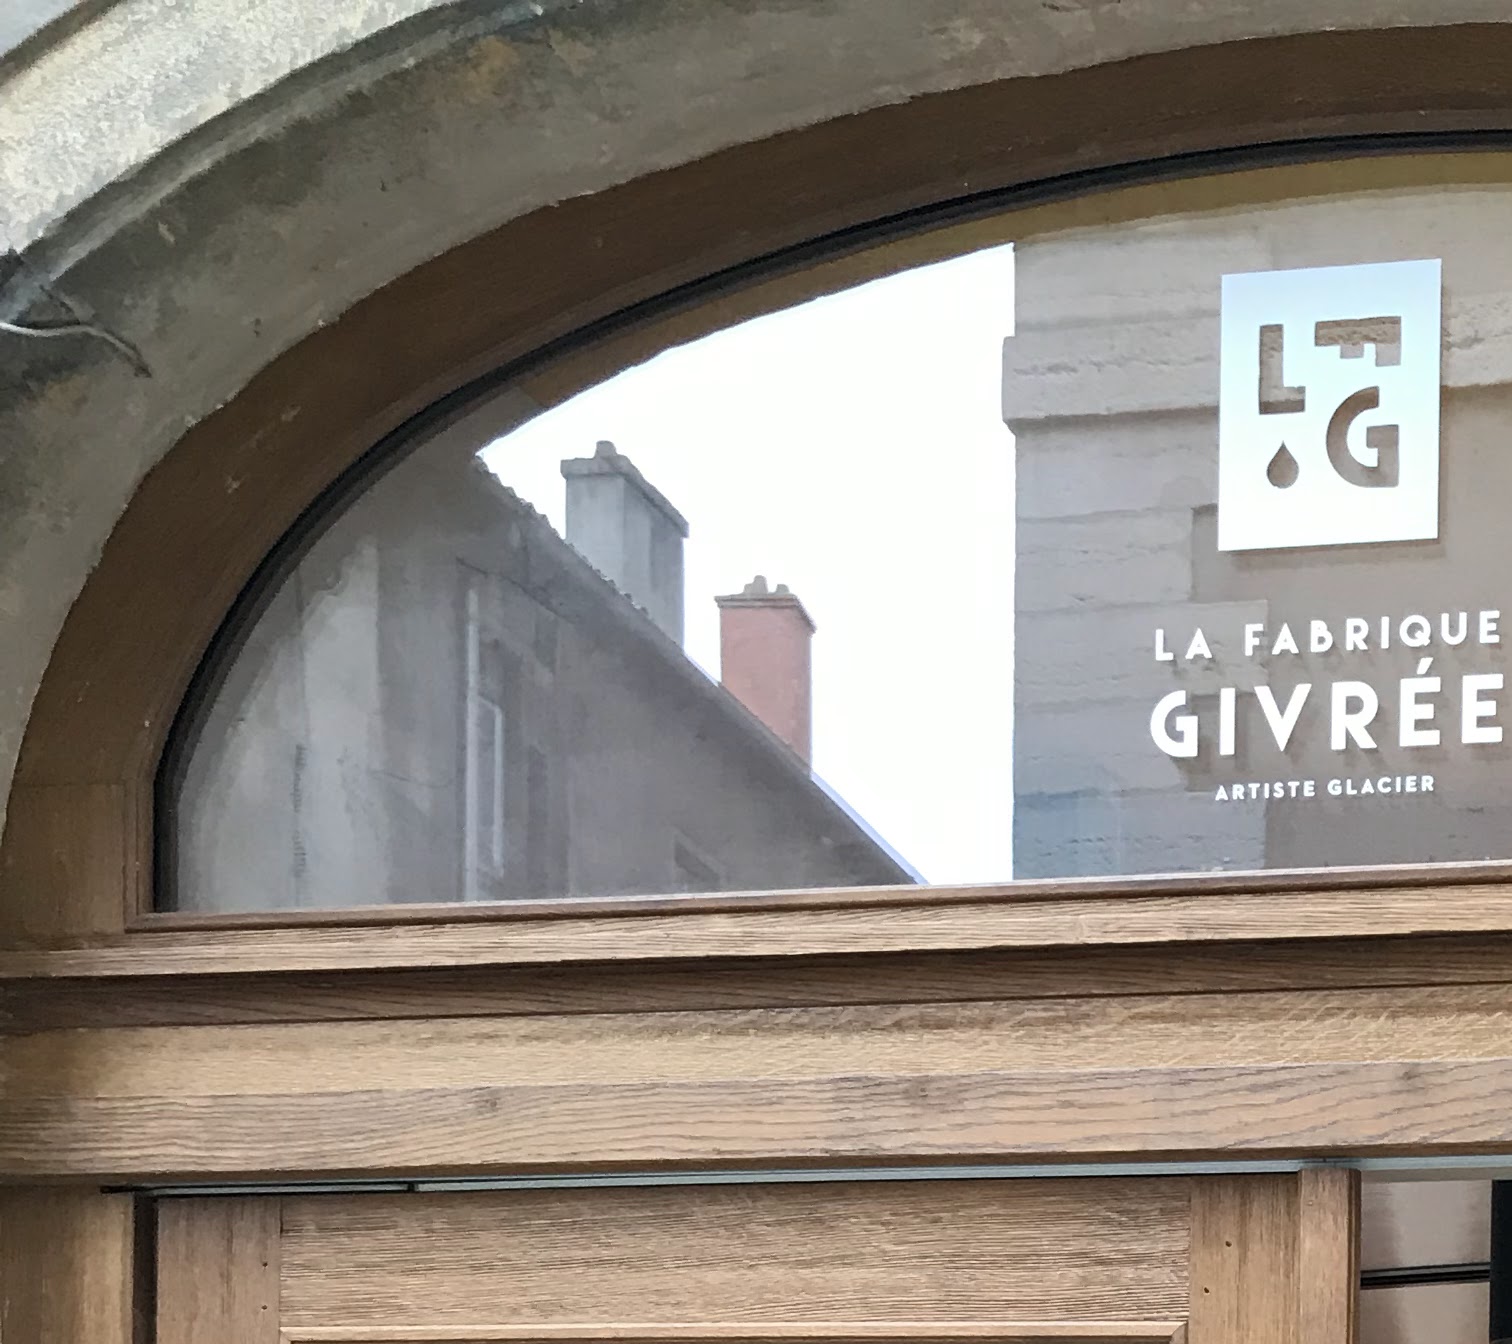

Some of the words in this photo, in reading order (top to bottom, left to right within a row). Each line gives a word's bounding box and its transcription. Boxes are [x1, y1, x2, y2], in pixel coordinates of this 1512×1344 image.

[1154, 627, 1213, 661] LA
[1244, 610, 1501, 656] FABRIQUE
[1150, 657, 1504, 758] GIVRÉE
[1215, 779, 1315, 801] ARTISTE
[1327, 775, 1435, 796] GLACIER
